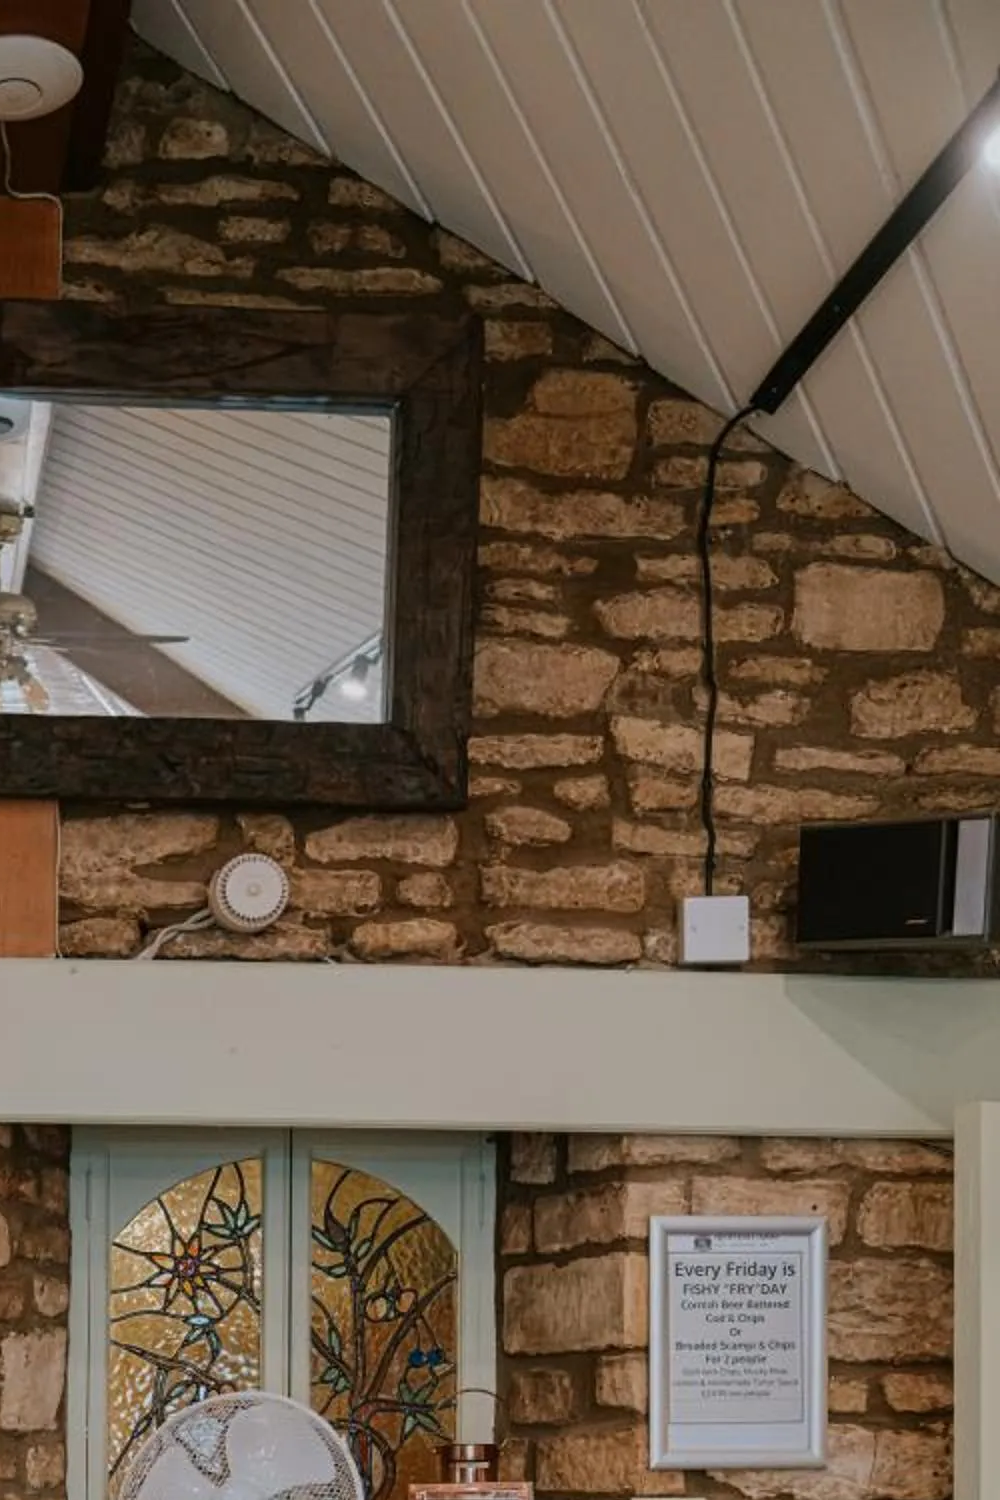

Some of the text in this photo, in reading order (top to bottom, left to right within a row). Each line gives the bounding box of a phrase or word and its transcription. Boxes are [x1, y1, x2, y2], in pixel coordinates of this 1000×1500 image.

[674, 1260, 796, 1280] Every Friday is
